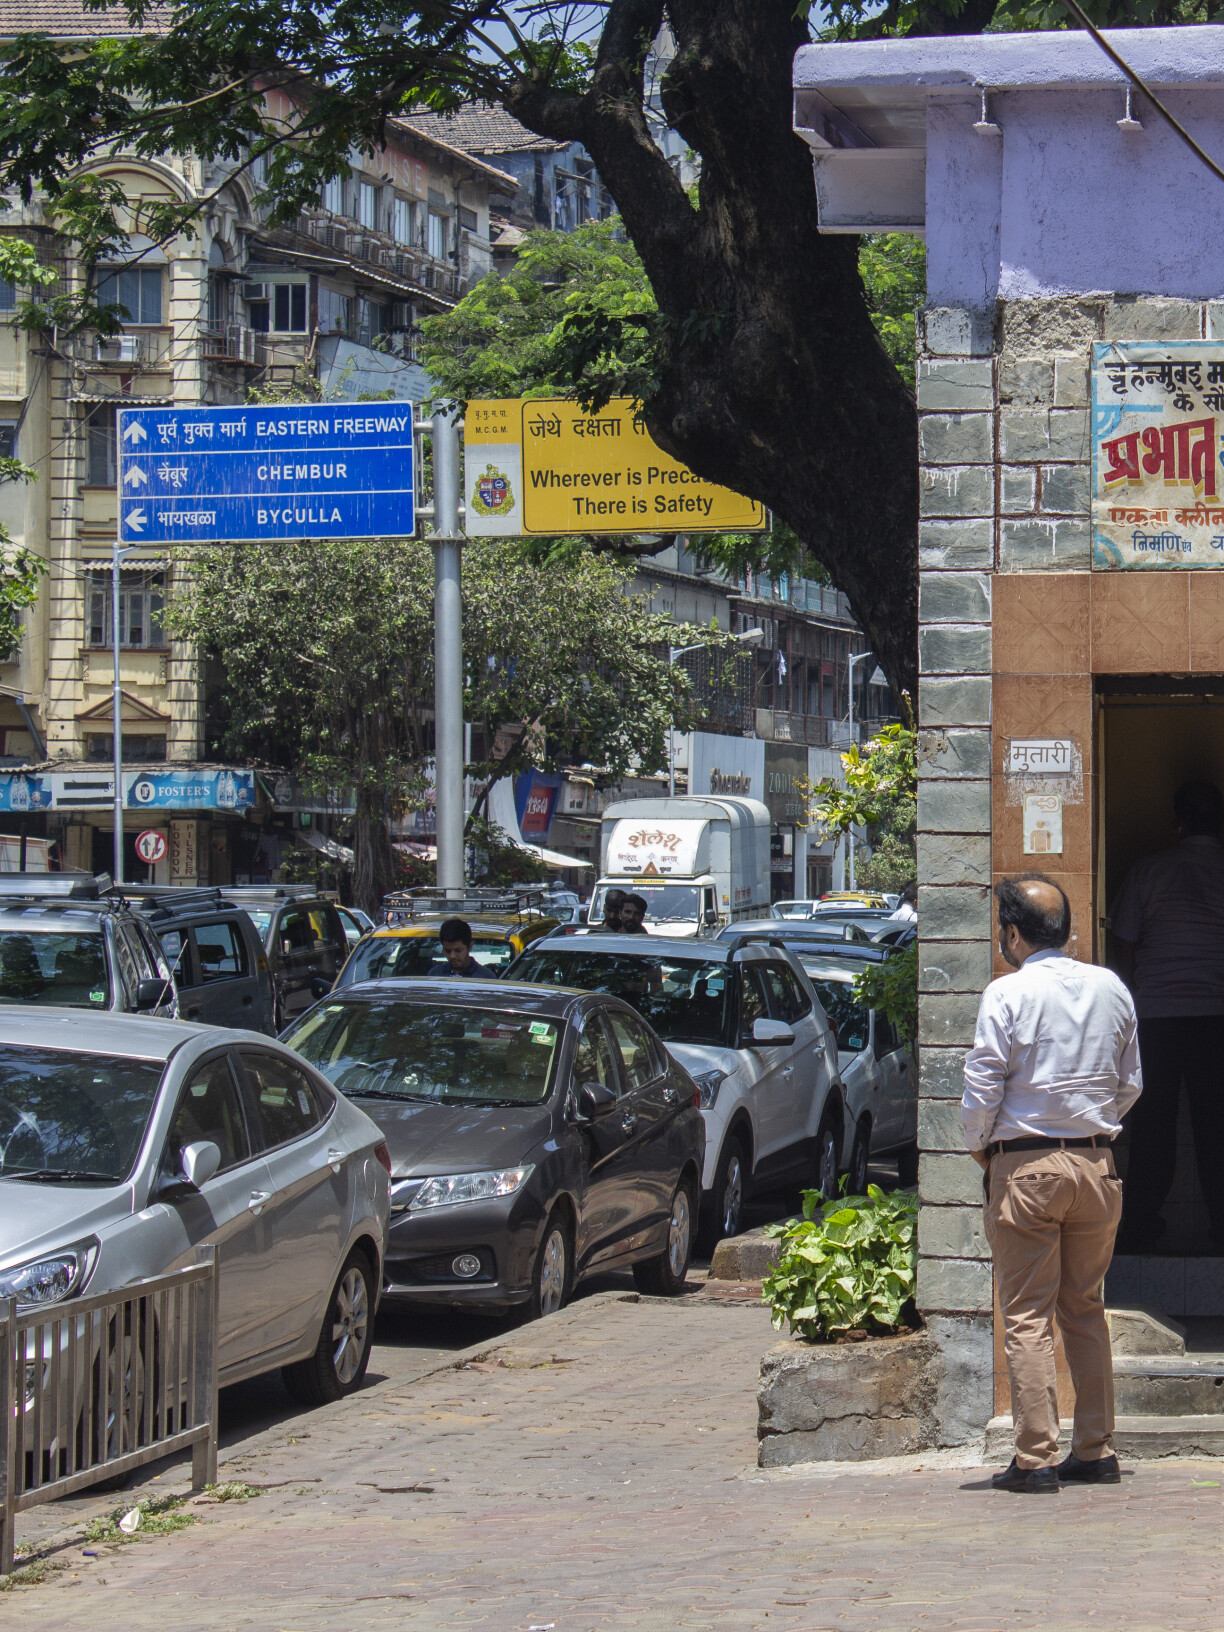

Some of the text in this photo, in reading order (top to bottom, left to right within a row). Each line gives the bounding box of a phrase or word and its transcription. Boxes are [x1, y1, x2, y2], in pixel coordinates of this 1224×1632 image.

[1173, 386, 1195, 412] के
[157, 416, 247, 444] पूर्व मुक्त मार्ग
[256, 416, 408, 437] EASTERN FREEWAY
[528, 413, 562, 438] जेथे
[572, 418, 622, 437] दक्षता
[1101, 417, 1218, 502] प्रभात
[157, 462, 189, 488] चेंबूर
[257, 464, 347, 480] CHEMBUR
[530, 468, 622, 489] Wherever
[626, 468, 642, 486] is
[257, 508, 343, 525] BYCULLA
[573, 493, 714, 517] There is Safety
[157, 510, 217, 527] भायखळा
[1012, 741, 1069, 772] मुतारी
[158, 786, 211, 797] FOSTER'S
